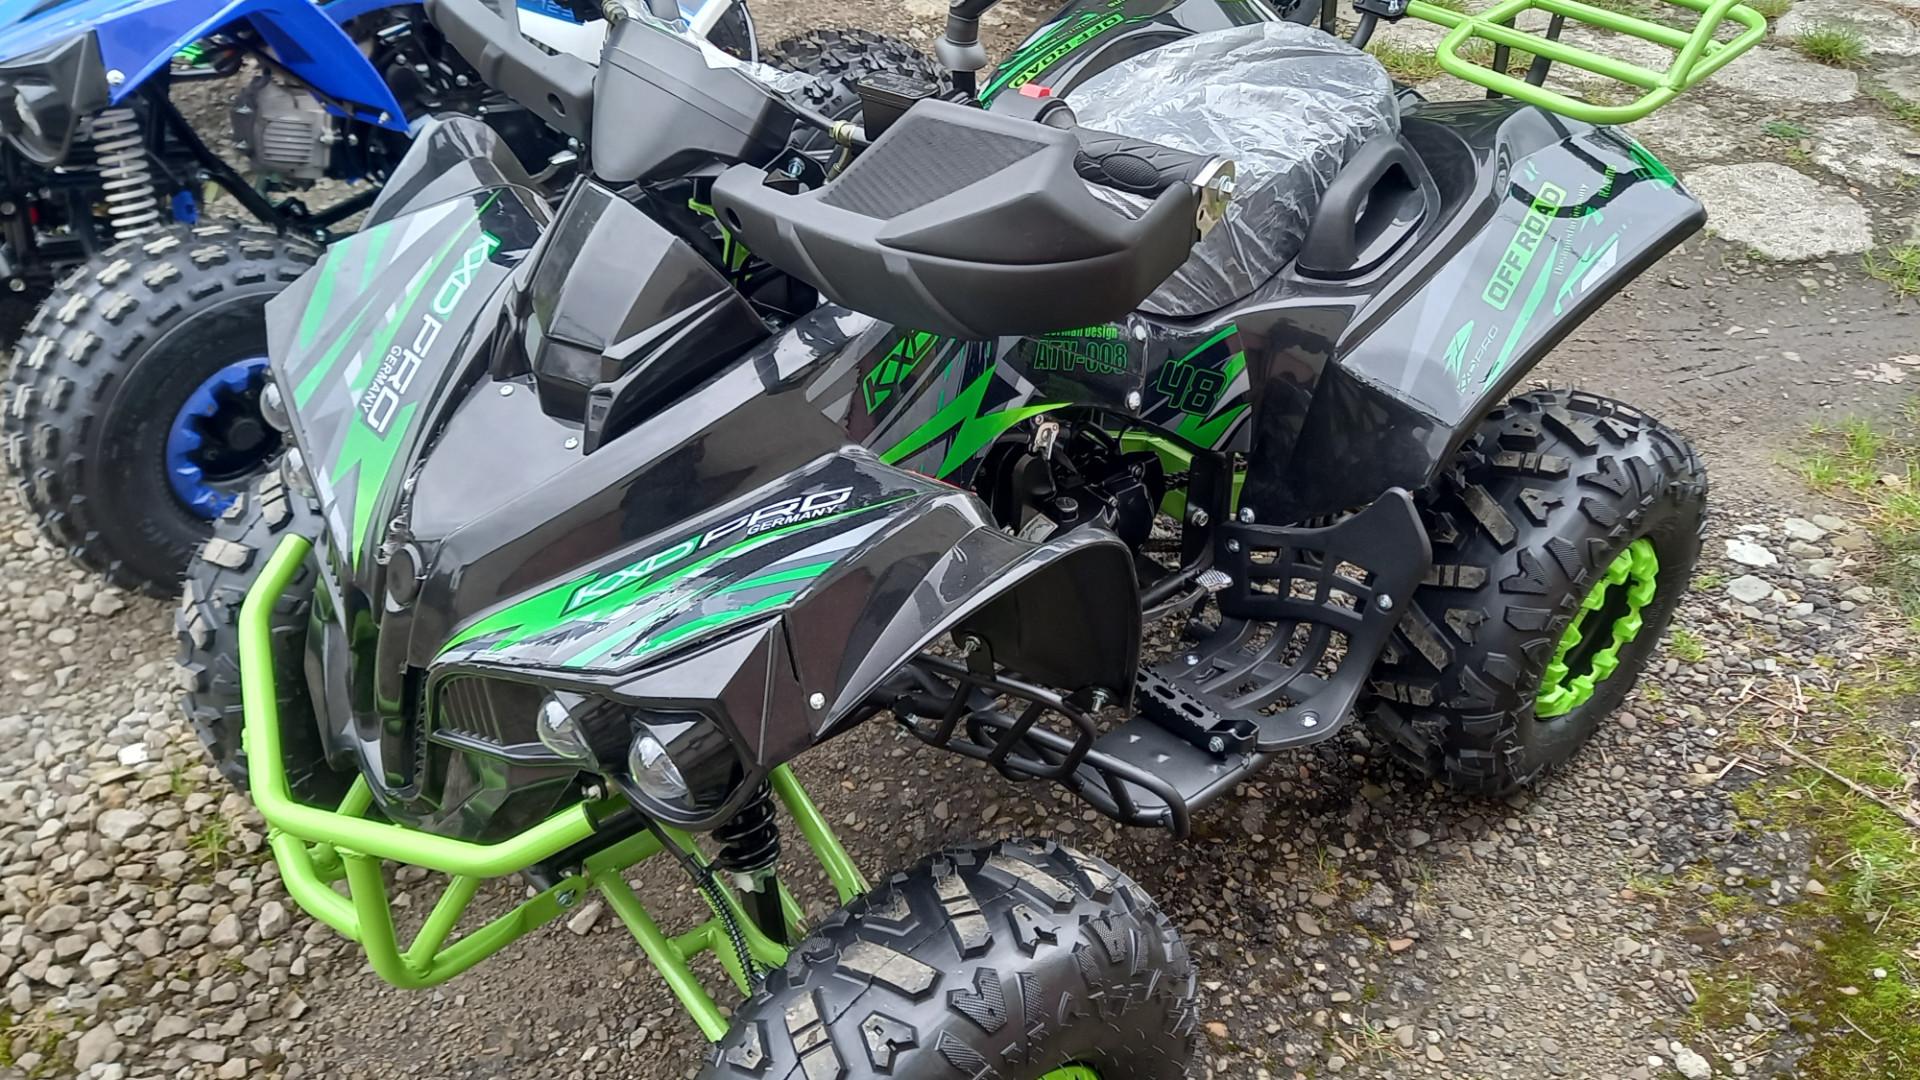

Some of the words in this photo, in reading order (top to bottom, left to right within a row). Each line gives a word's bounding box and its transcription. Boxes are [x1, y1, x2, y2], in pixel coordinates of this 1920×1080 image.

[1074, 16, 1119, 45] OFF
[1014, 43, 1072, 88] ROAD
[1487, 249, 1526, 305] OFF
[1516, 187, 1561, 252] ROAD
[360, 345, 401, 414] GERMANY
[1034, 340, 1127, 374] ATV-008
[1156, 360, 1227, 416] 48
[747, 504, 839, 536] GERMANY
